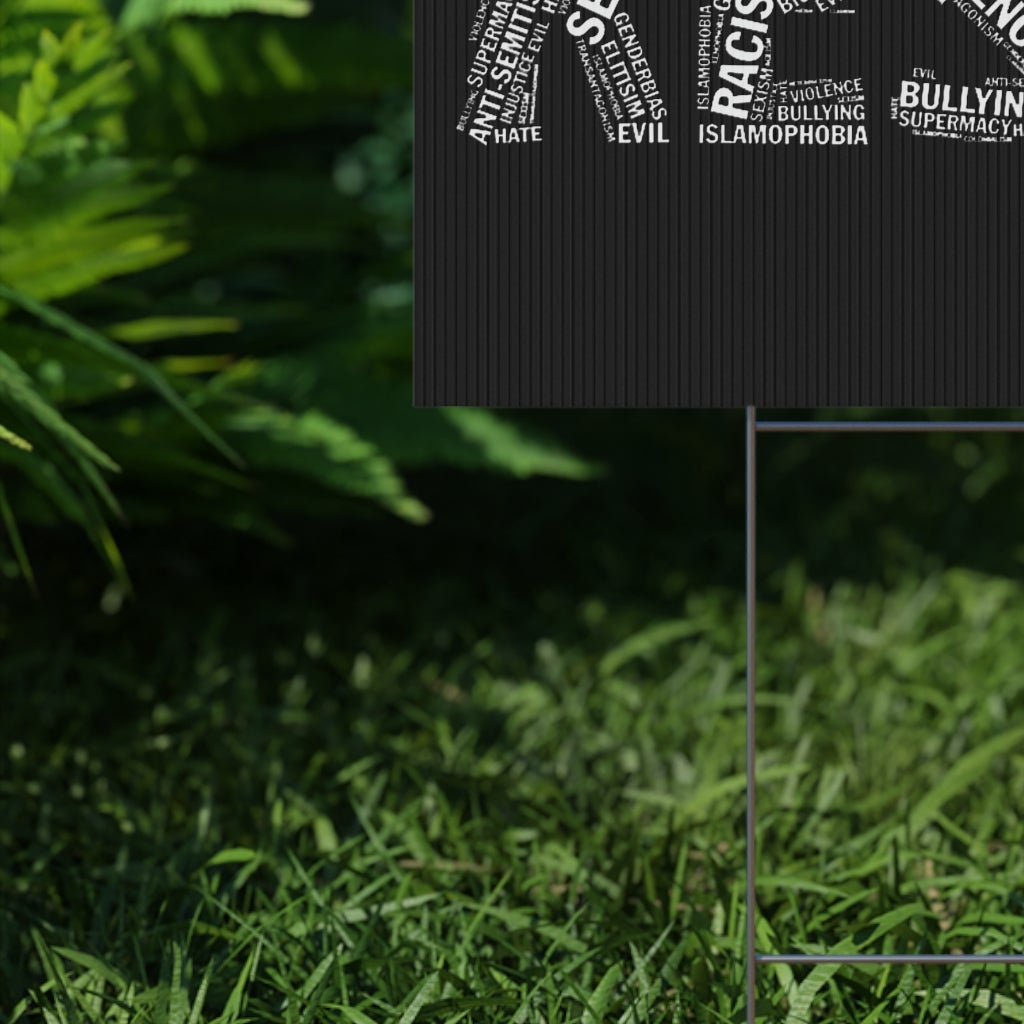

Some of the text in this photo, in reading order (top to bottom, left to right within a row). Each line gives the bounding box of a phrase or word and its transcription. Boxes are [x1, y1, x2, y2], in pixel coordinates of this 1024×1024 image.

[527, 22, 551, 53] EVIL
[614, 12, 668, 121] GENDERBIAS
[697, 4, 712, 110] ISLAMOPHOBIA
[601, 40, 646, 120] ELITISIM
[913, 67, 937, 80] EVIL
[499, 51, 535, 125] INJUSTICE
[576, 38, 616, 143] TRANSANTAGONISM
[751, 68, 774, 122] SEXISM
[789, 78, 864, 103] VIOLENCE
[778, 104, 866, 122] BULLYING
[899, 110, 1013, 136] SUPERMACY
[494, 126, 543, 144] HATE
[618, 122, 670, 144] EVIL
[698, 123, 869, 145] ISLAMOPHOBIA
